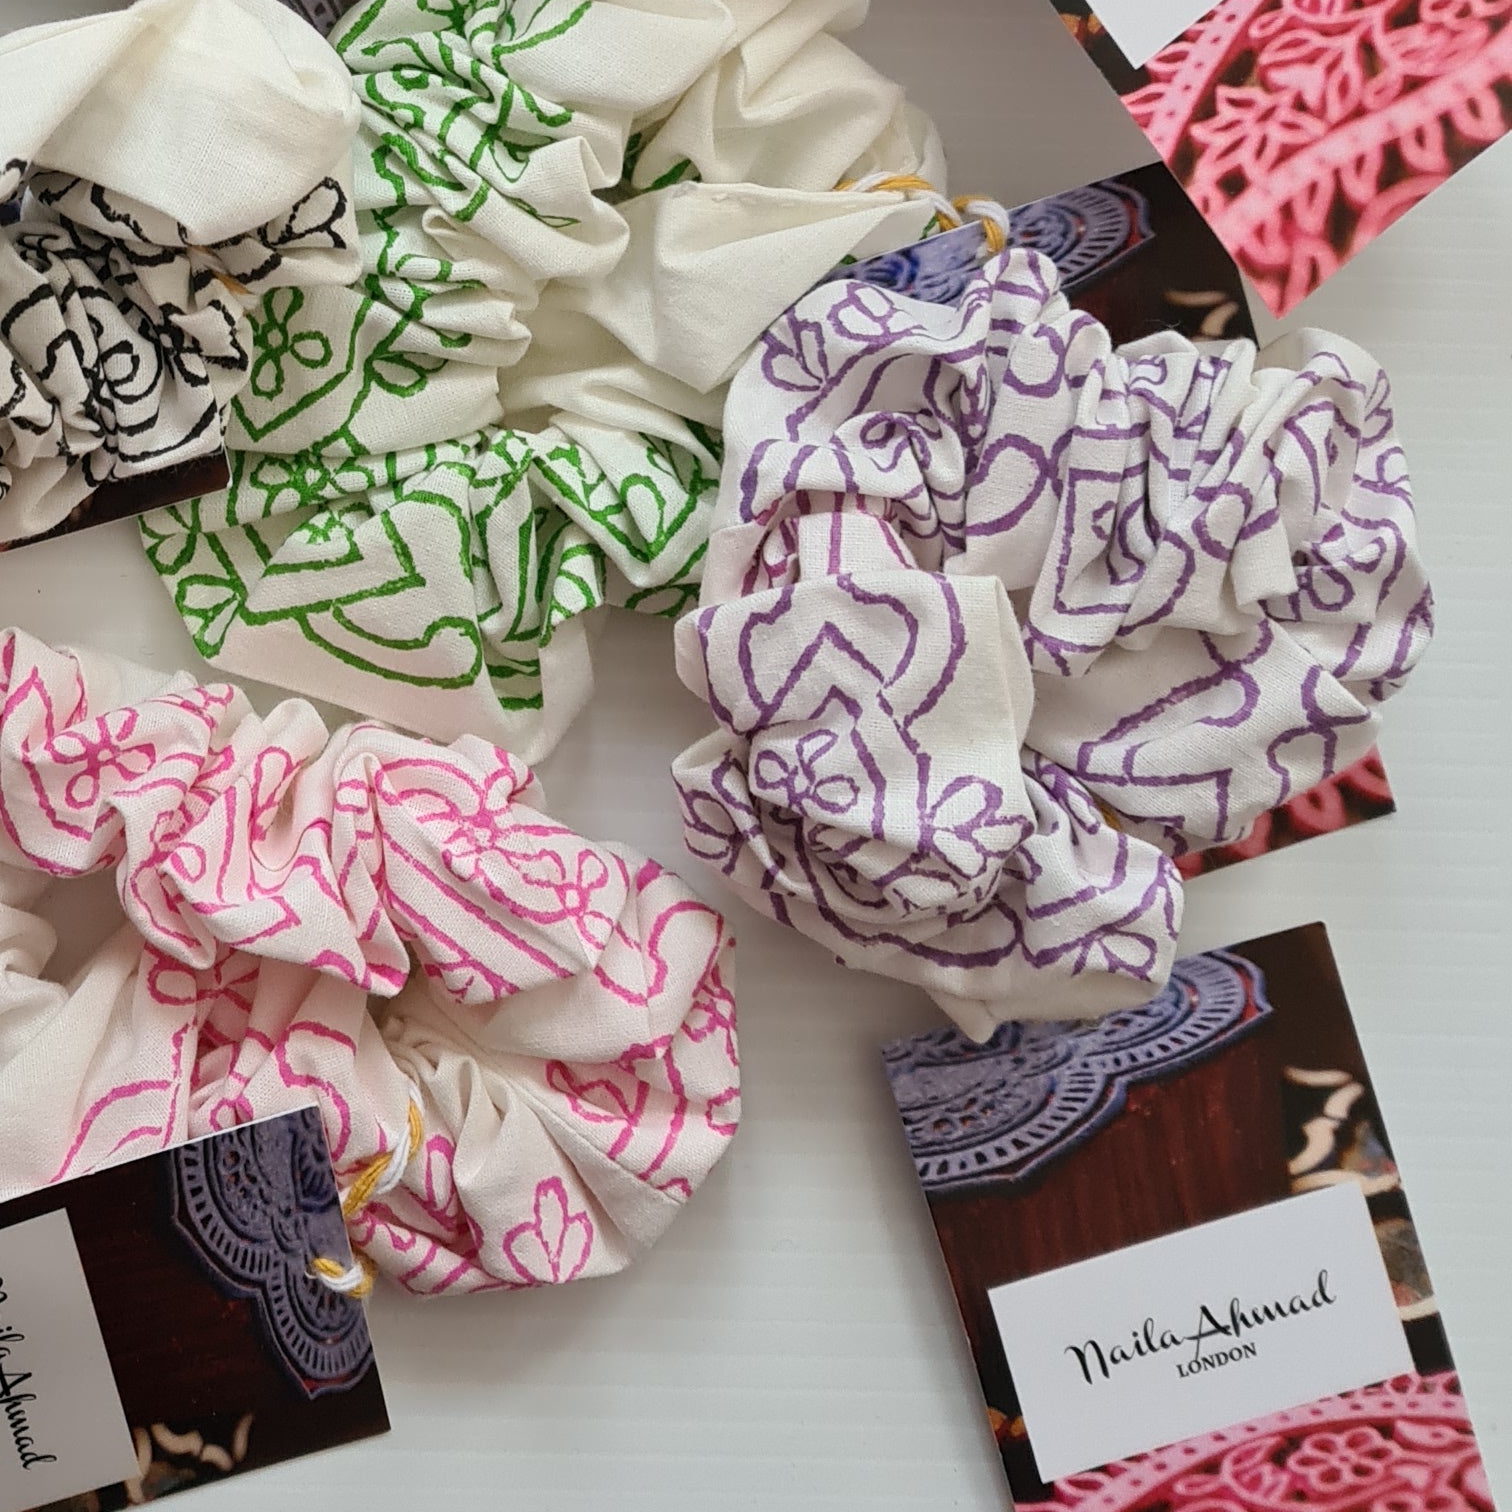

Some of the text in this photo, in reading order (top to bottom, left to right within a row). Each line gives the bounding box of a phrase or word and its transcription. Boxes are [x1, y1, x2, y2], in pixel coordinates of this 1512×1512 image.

[1065, 1269, 1337, 1385] Naila Ahmad
[1176, 1342, 1258, 1379] LONDON
